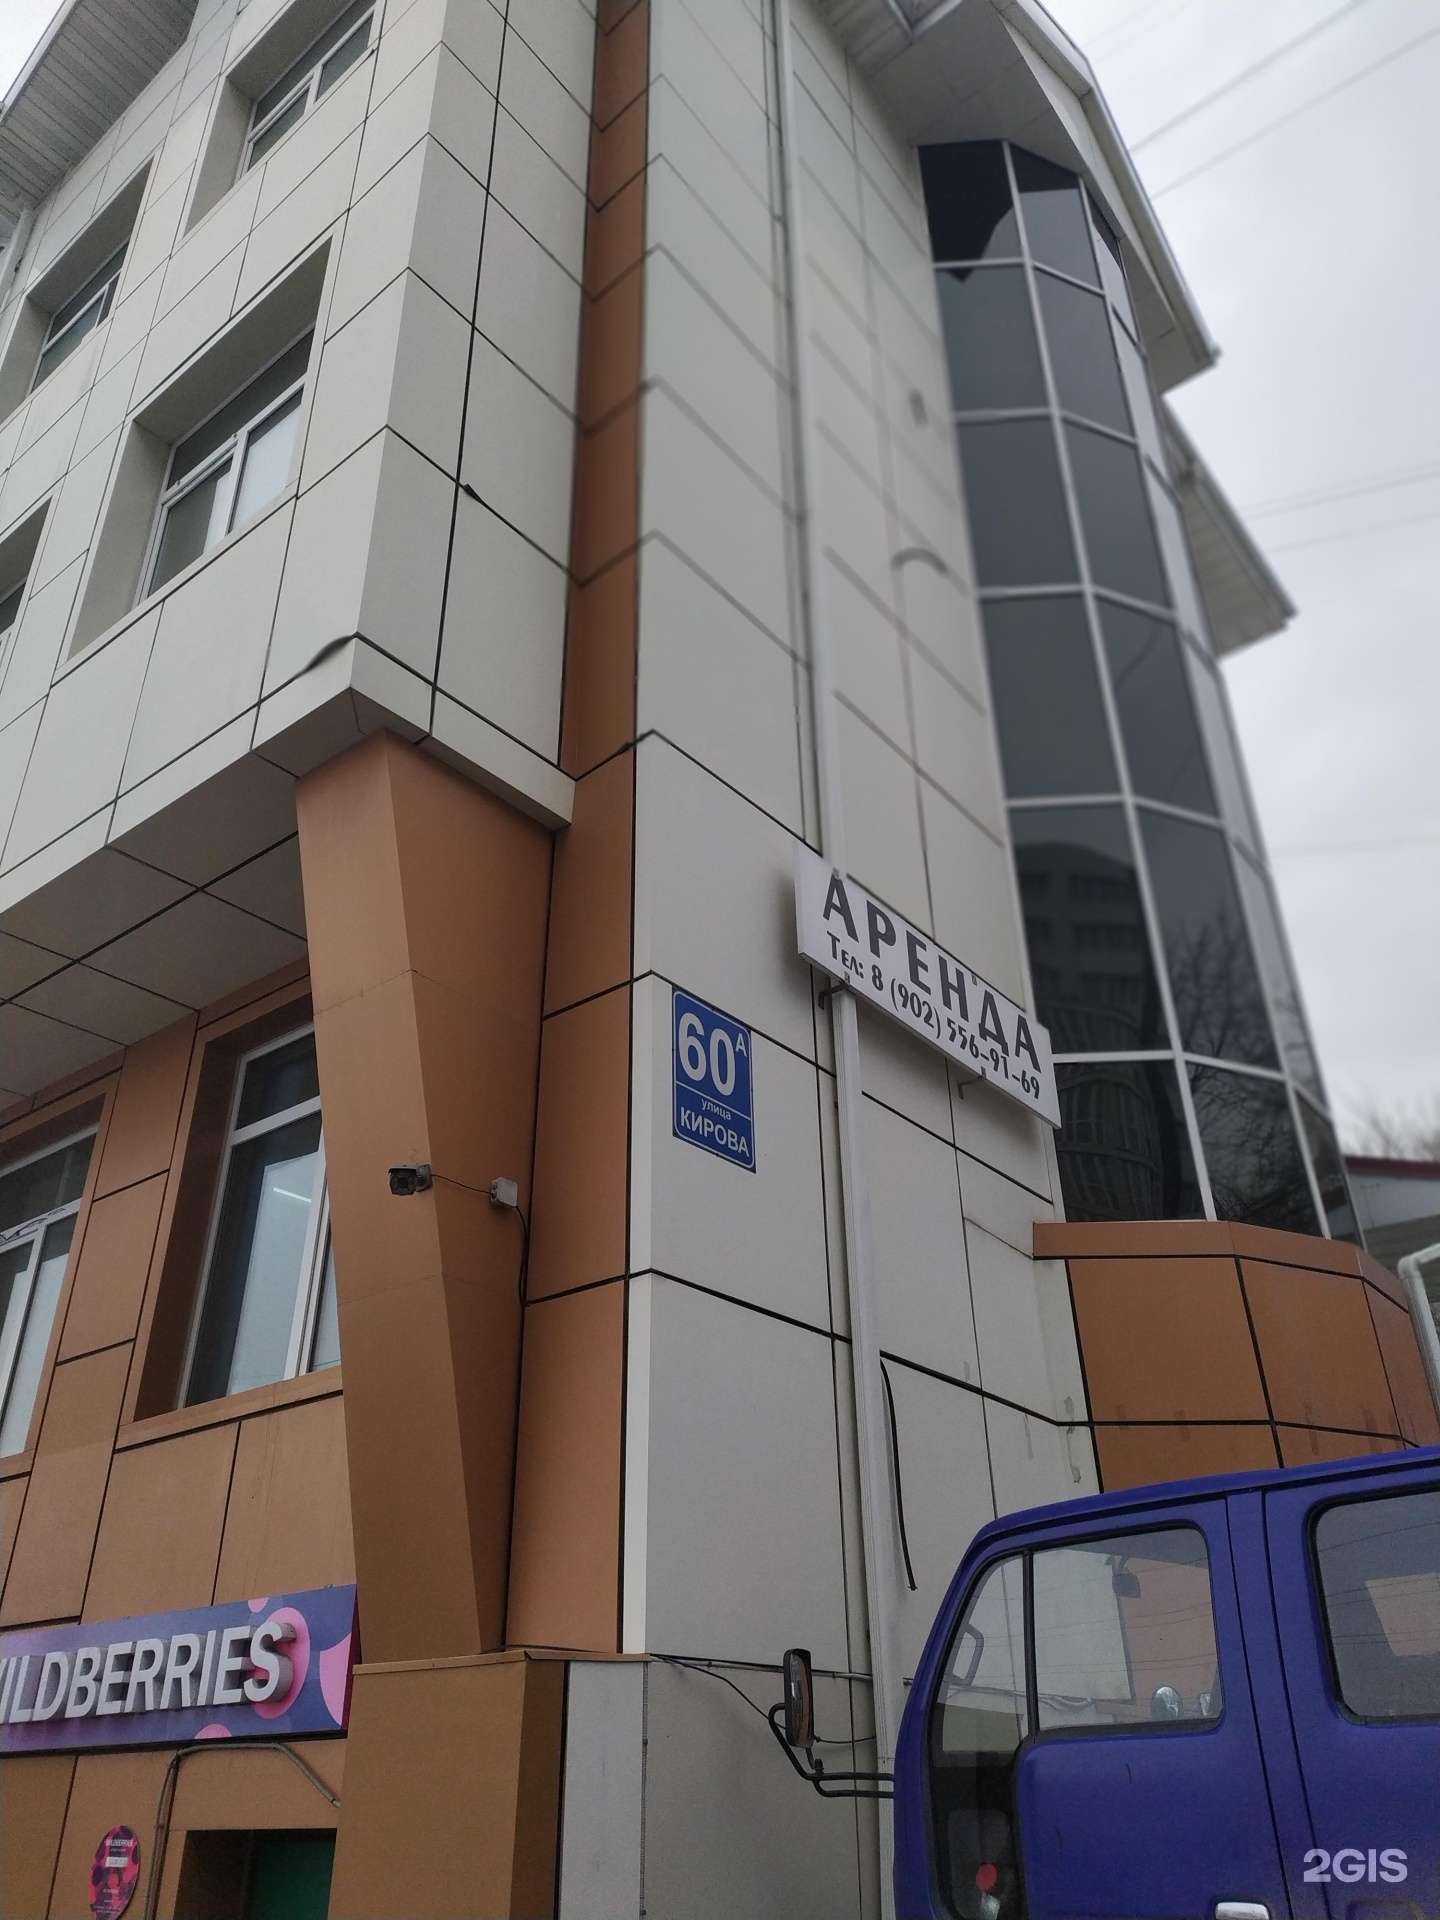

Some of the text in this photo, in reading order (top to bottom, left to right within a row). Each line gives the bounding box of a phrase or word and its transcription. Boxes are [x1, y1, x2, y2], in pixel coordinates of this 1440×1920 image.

[823, 872, 1042, 1074] АРЕНДА
[872, 964, 884, 991] 8
[890, 977, 941, 1039] (902)
[946, 1017, 1040, 1099] 556-91-69
[680, 1106, 750, 1157] КИРОВА
[701, 1098, 732, 1120] улица
